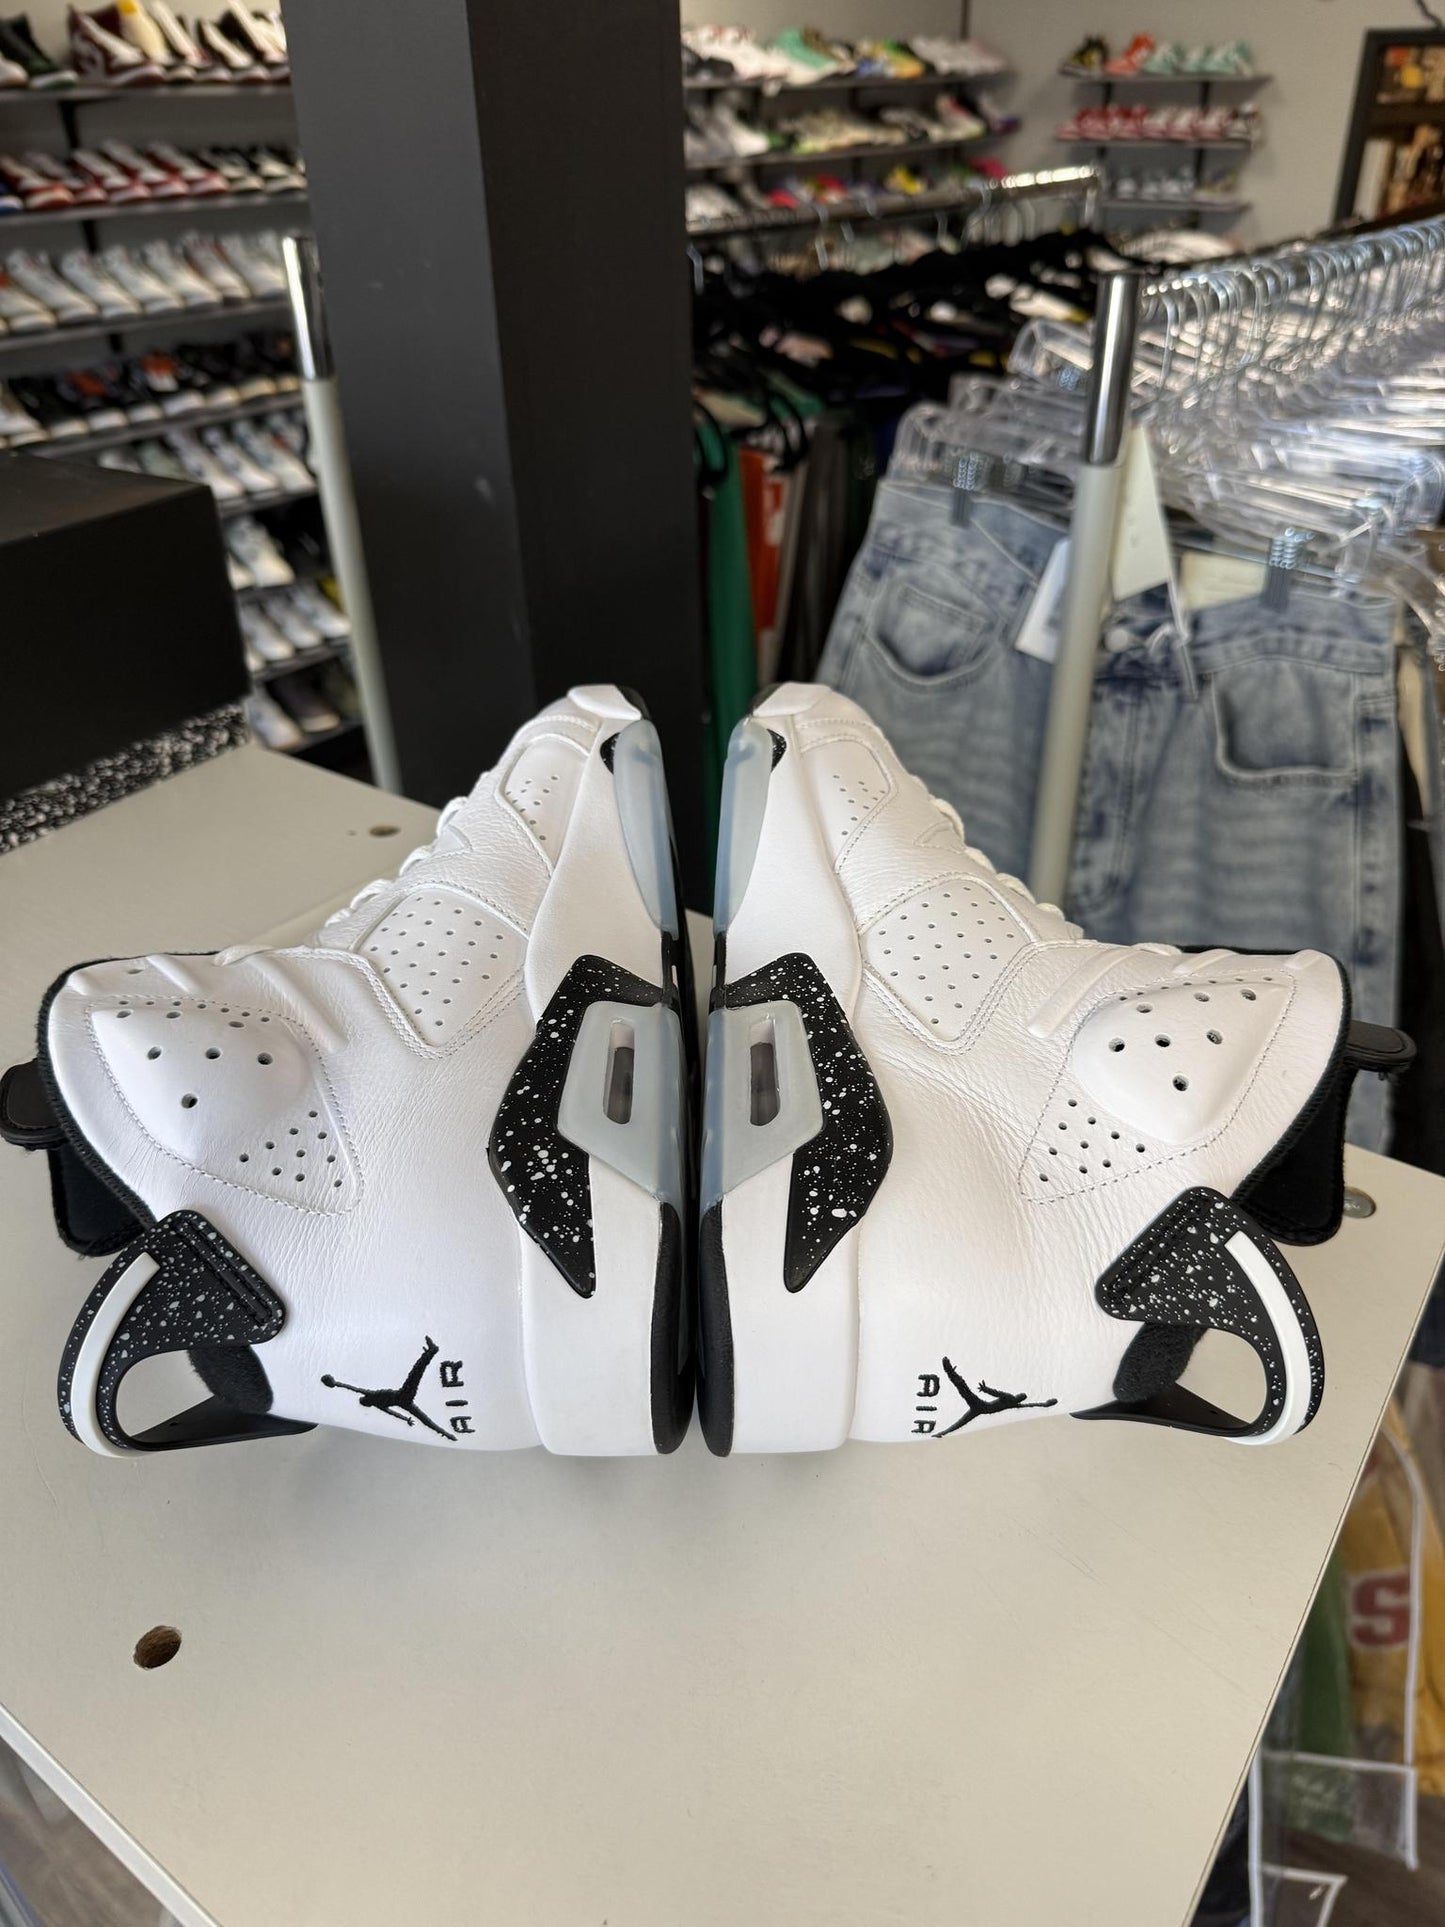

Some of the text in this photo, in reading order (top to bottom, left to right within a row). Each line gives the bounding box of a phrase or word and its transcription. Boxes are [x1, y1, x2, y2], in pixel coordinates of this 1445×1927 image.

[439, 1359, 476, 1434] AIR
[911, 1373, 941, 1434] AIR
[1350, 1570, 1412, 1650] S
